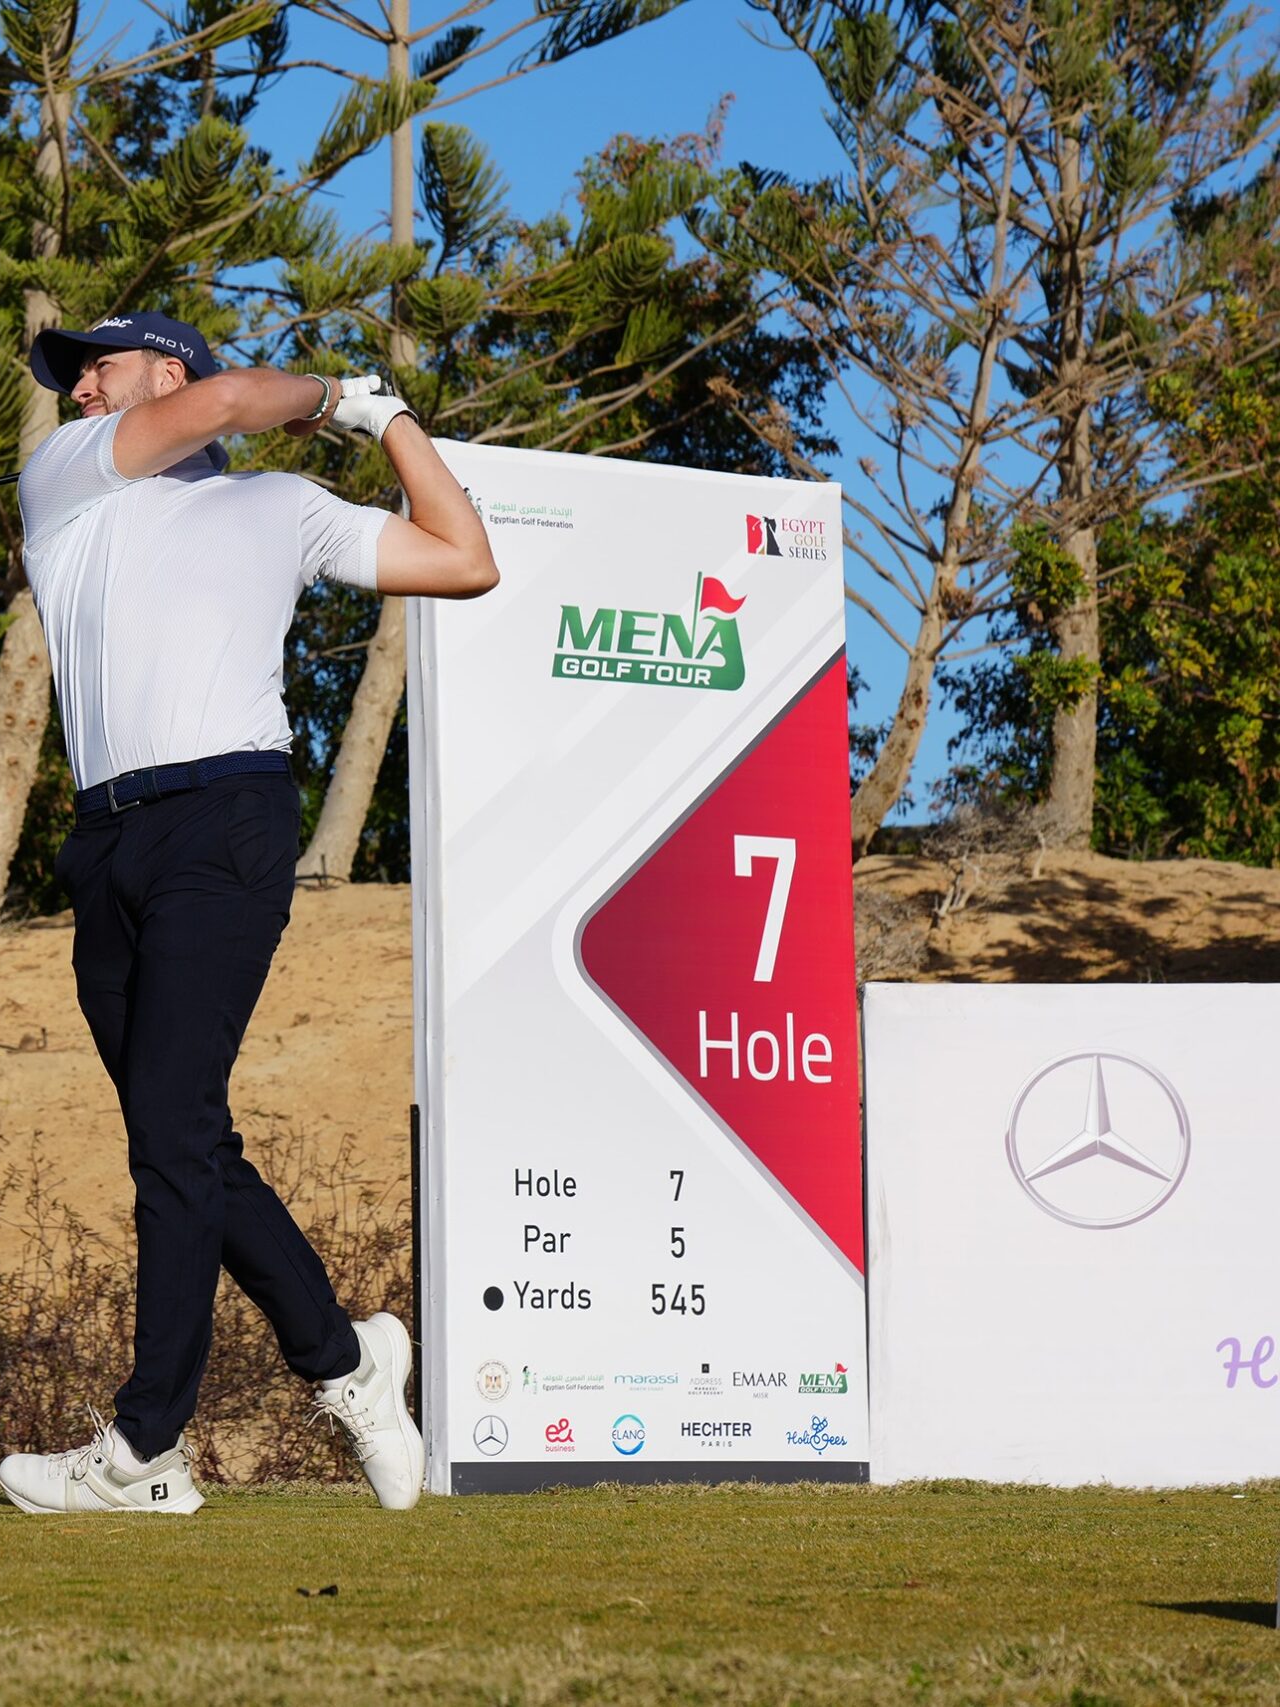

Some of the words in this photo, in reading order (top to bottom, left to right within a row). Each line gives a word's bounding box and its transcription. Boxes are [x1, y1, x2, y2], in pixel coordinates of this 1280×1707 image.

[144, 332, 177, 348] PRO
[180, 341, 195, 359] V1
[489, 514, 520, 526] Egyptian
[521, 517, 536, 526] Golf
[536, 519, 574, 529] Federation
[781, 518, 826, 534] EGYPT
[794, 533, 826, 548] GOLF
[788, 546, 827, 561] SERIES
[556, 604, 740, 660] MENA
[561, 657, 632, 679] GOLF
[639, 662, 713, 686] TOUR
[733, 834, 797, 983] 7
[698, 1010, 833, 1084] Hole
[514, 1168, 577, 1197] Hole
[669, 1169, 685, 1202] 7
[524, 1224, 571, 1253] Par
[670, 1226, 686, 1259] 5
[513, 1280, 592, 1310] Yards
[651, 1283, 706, 1316] 545
[614, 1372, 679, 1385] marassi
[732, 1371, 788, 1387] EMAAR
[799, 1373, 848, 1386] MENA
[542, 1383, 565, 1391] Egyptian
[611, 1429, 646, 1441] ELANO
[681, 1422, 752, 1437] HECHTER
[545, 1444, 576, 1453] business
[150, 1482, 169, 1501] FJ
